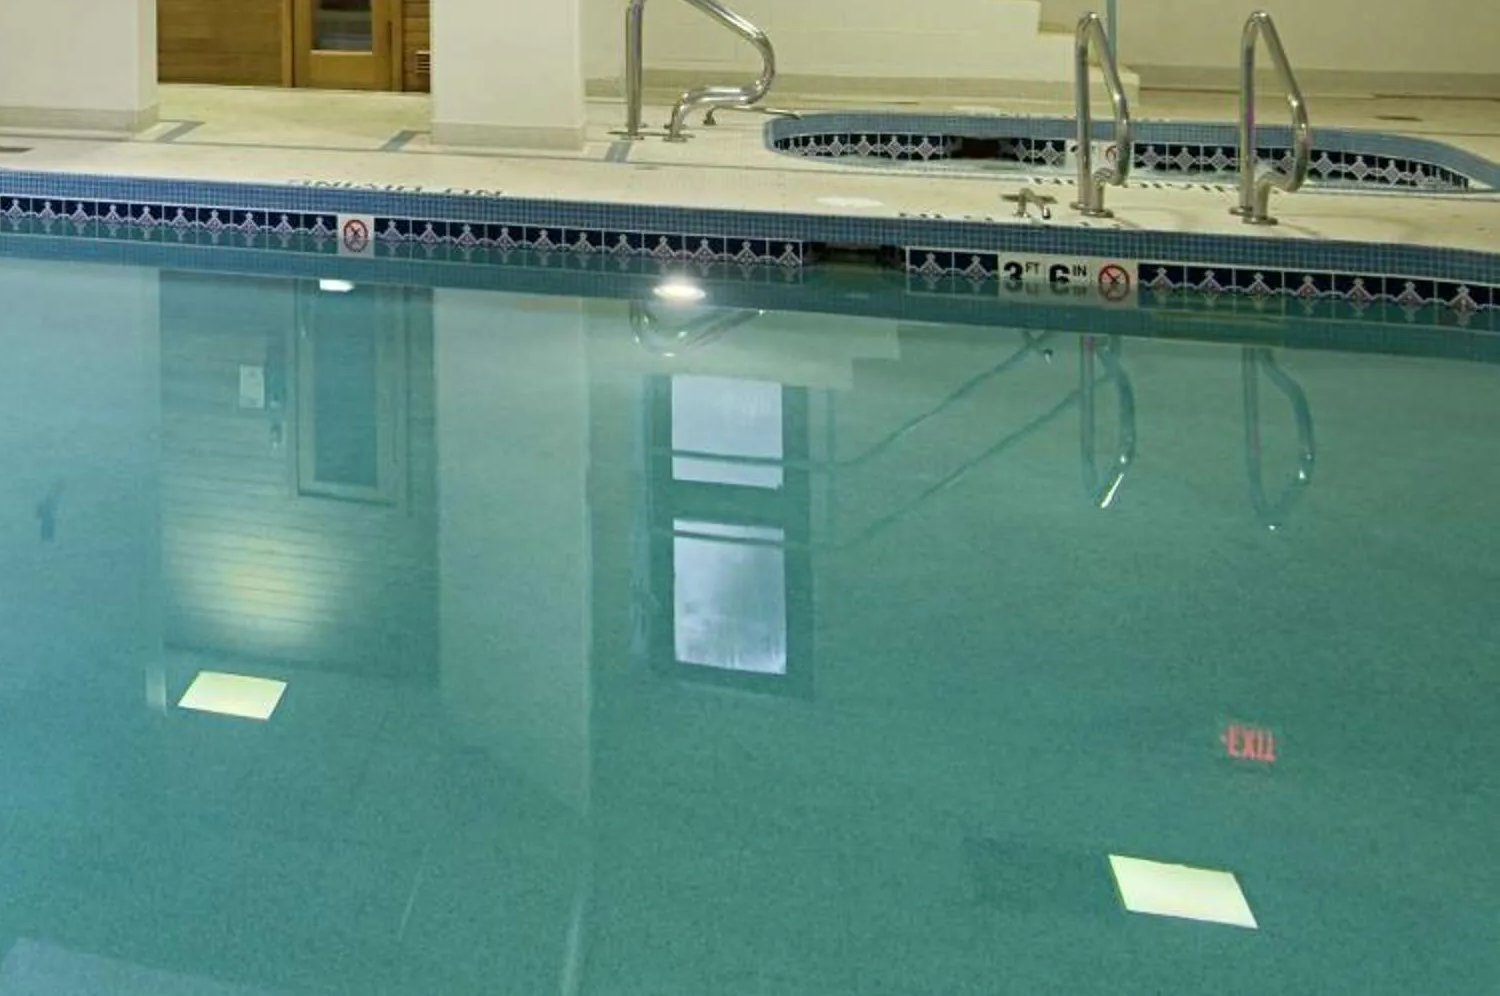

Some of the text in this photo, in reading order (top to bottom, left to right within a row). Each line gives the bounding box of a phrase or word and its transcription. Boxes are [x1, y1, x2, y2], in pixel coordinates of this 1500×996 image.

[1003, 260, 1087, 285] 3 FT 6 IN
